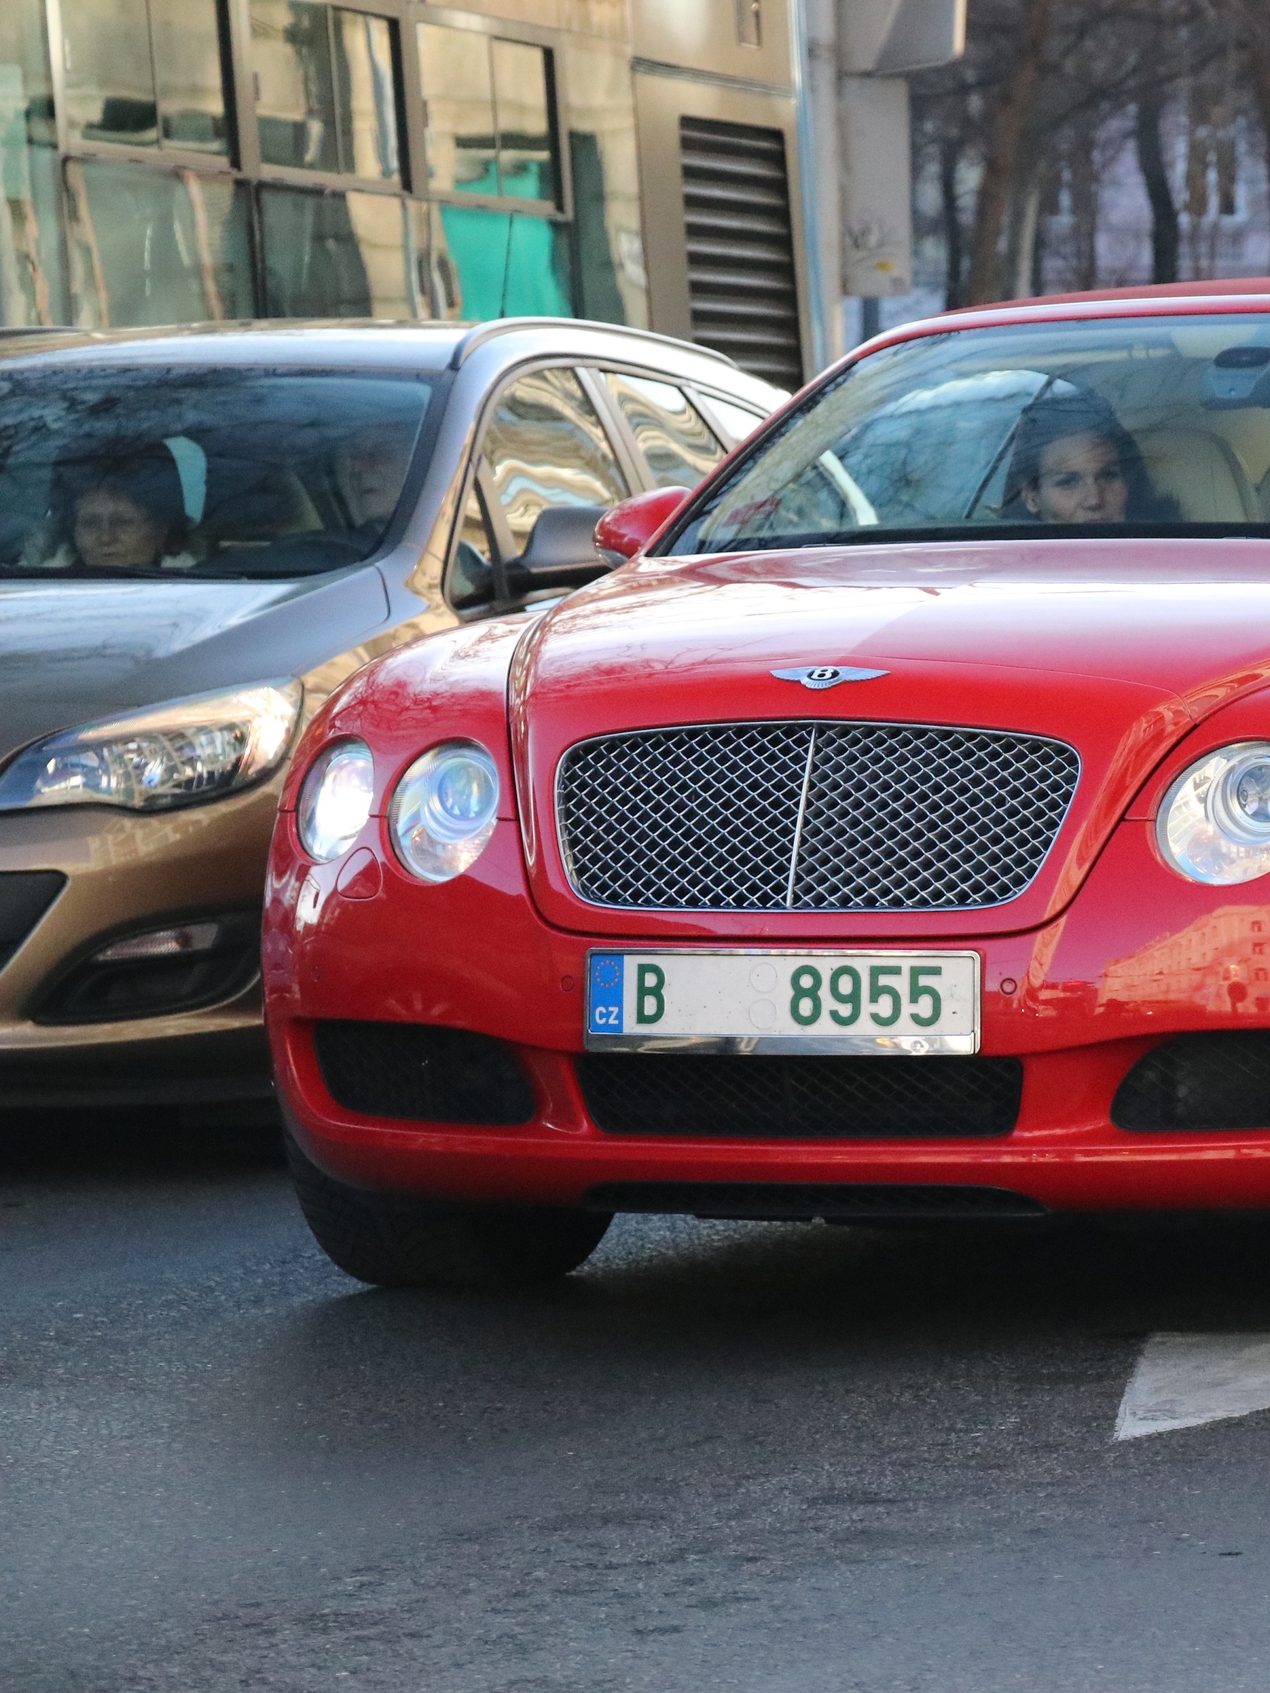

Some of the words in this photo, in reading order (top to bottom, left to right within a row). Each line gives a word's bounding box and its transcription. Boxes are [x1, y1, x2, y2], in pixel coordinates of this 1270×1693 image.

[811, 668, 834, 680] B
[636, 963, 666, 1025] B
[790, 964, 942, 1027] 8955
[595, 1007, 619, 1025] CZ
